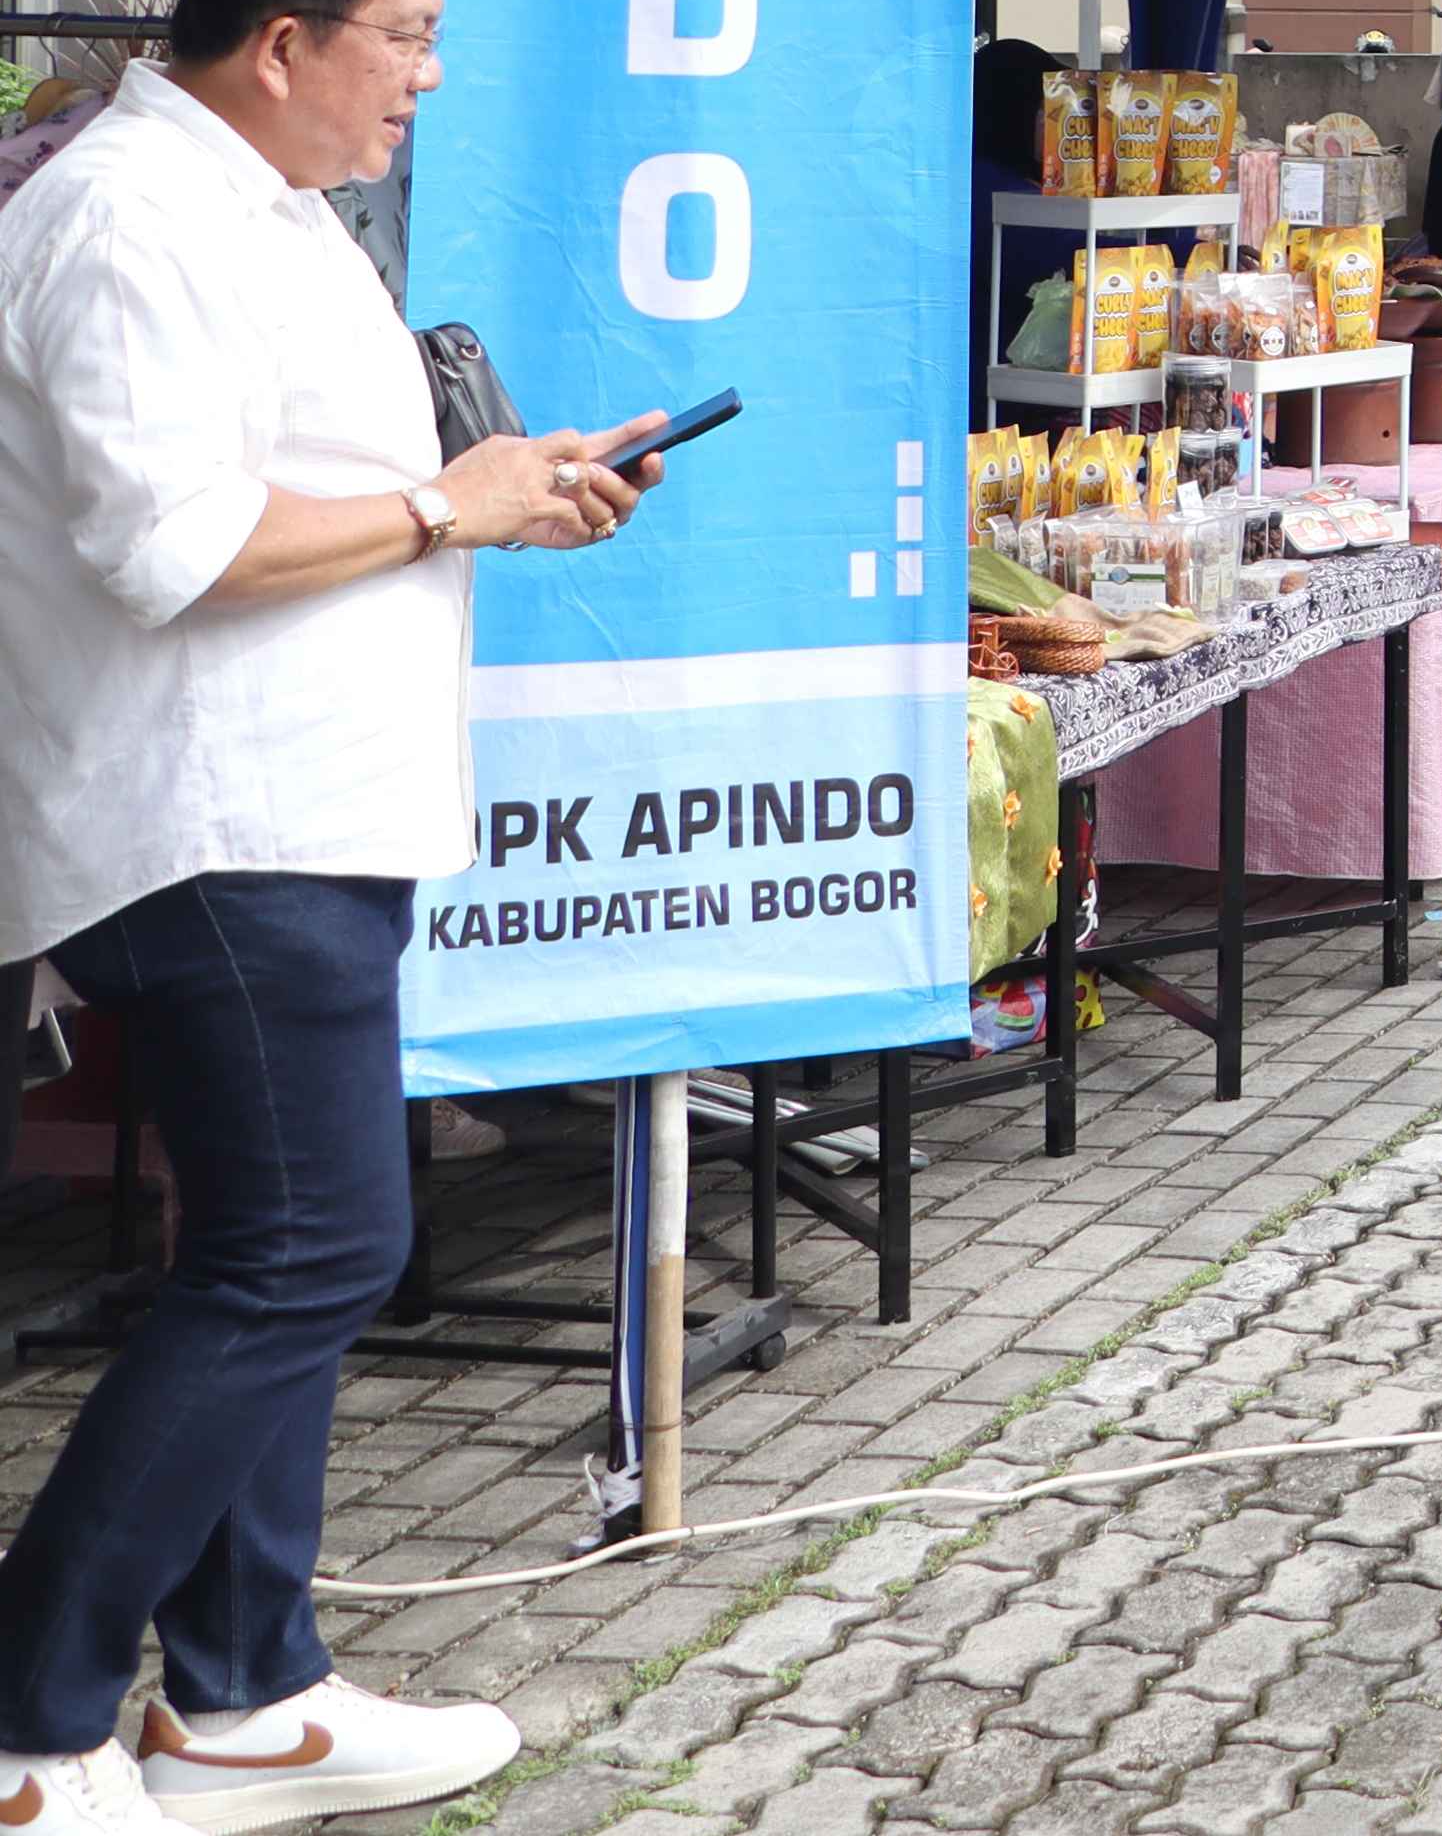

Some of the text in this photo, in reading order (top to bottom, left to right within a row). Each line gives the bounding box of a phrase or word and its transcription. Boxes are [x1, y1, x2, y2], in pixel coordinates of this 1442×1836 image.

[474, 771, 915, 868] PK APINDO
[428, 867, 918, 951] KABUPATEN BOGOR
